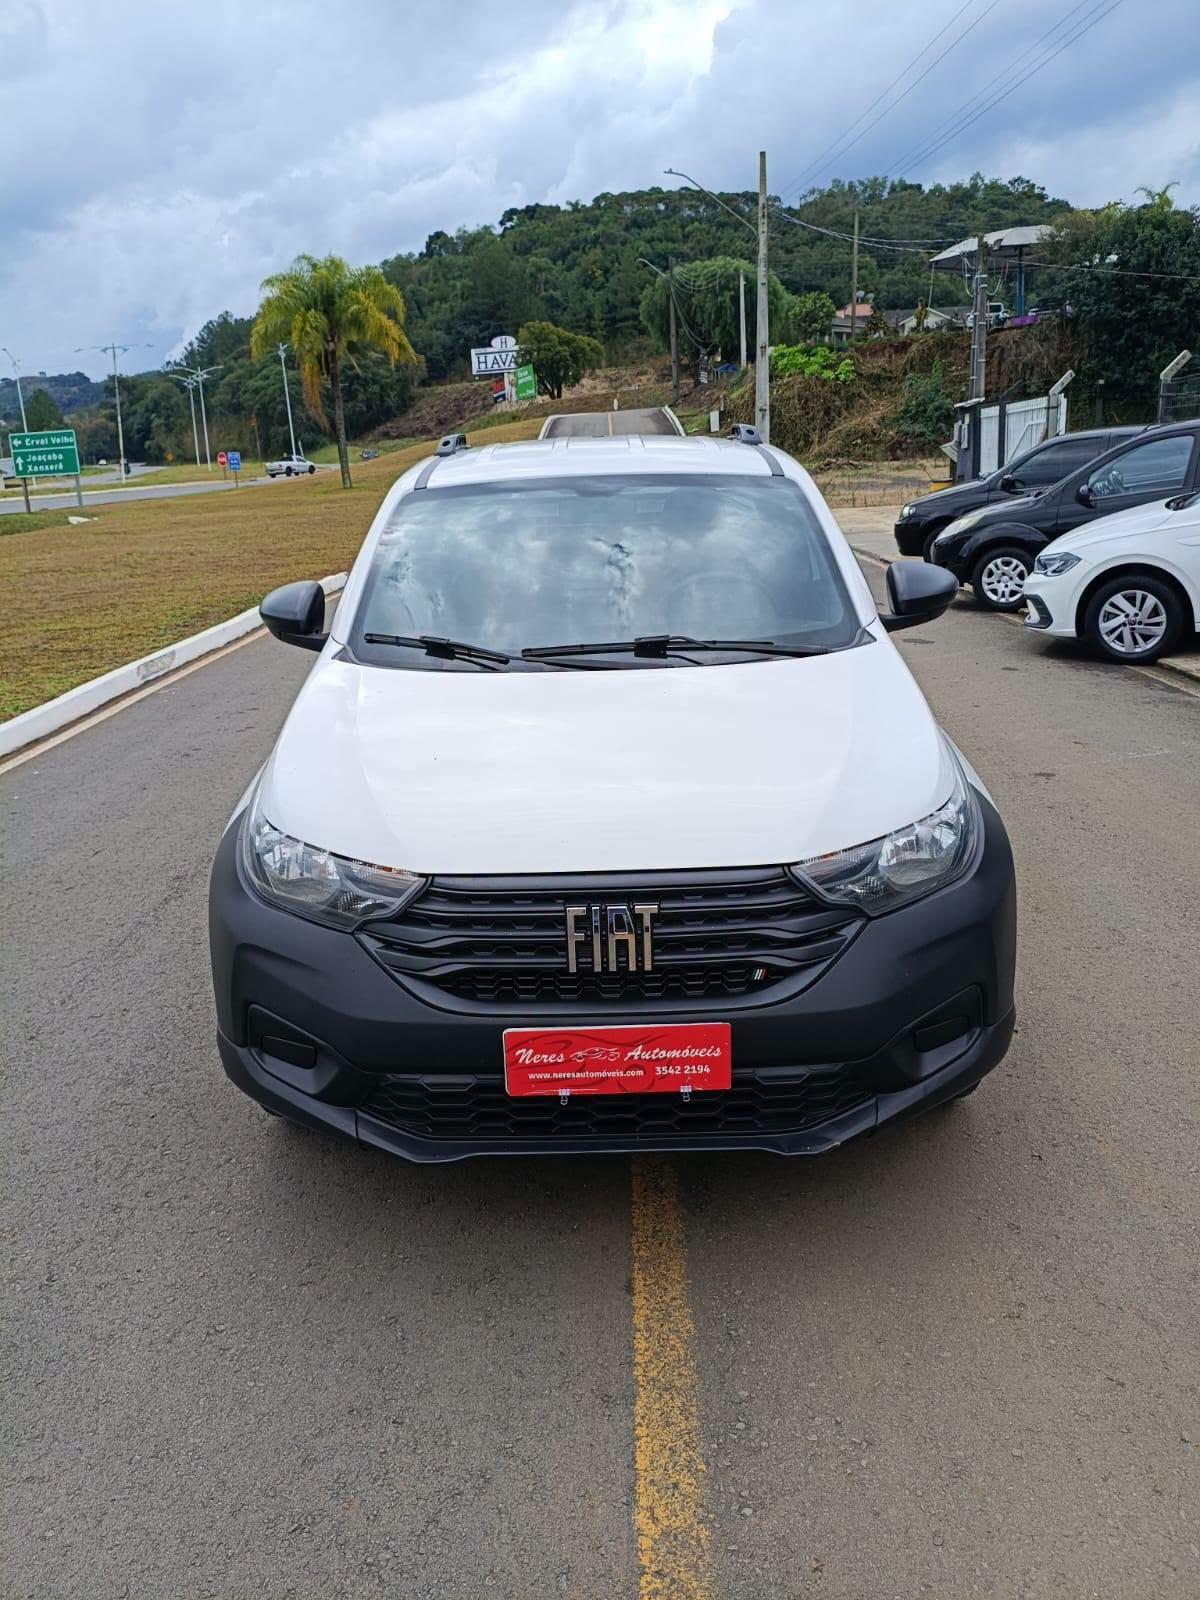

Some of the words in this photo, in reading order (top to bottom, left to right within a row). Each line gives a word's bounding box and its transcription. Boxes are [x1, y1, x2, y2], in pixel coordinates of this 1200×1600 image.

[500, 337, 507, 348] H
[477, 354, 516, 369] HAVA
[25, 437, 48, 446] Erval
[51, 436, 73, 444] Velho
[27, 453, 63, 462] Joaçaba
[27, 462, 63, 472] Xanxerê
[566, 905, 658, 973] FIAT
[515, 1048, 565, 1064] Neres
[624, 1044, 722, 1062] Automóveis
[655, 1066, 681, 1075] 3542
[684, 1065, 711, 1074] 2194
